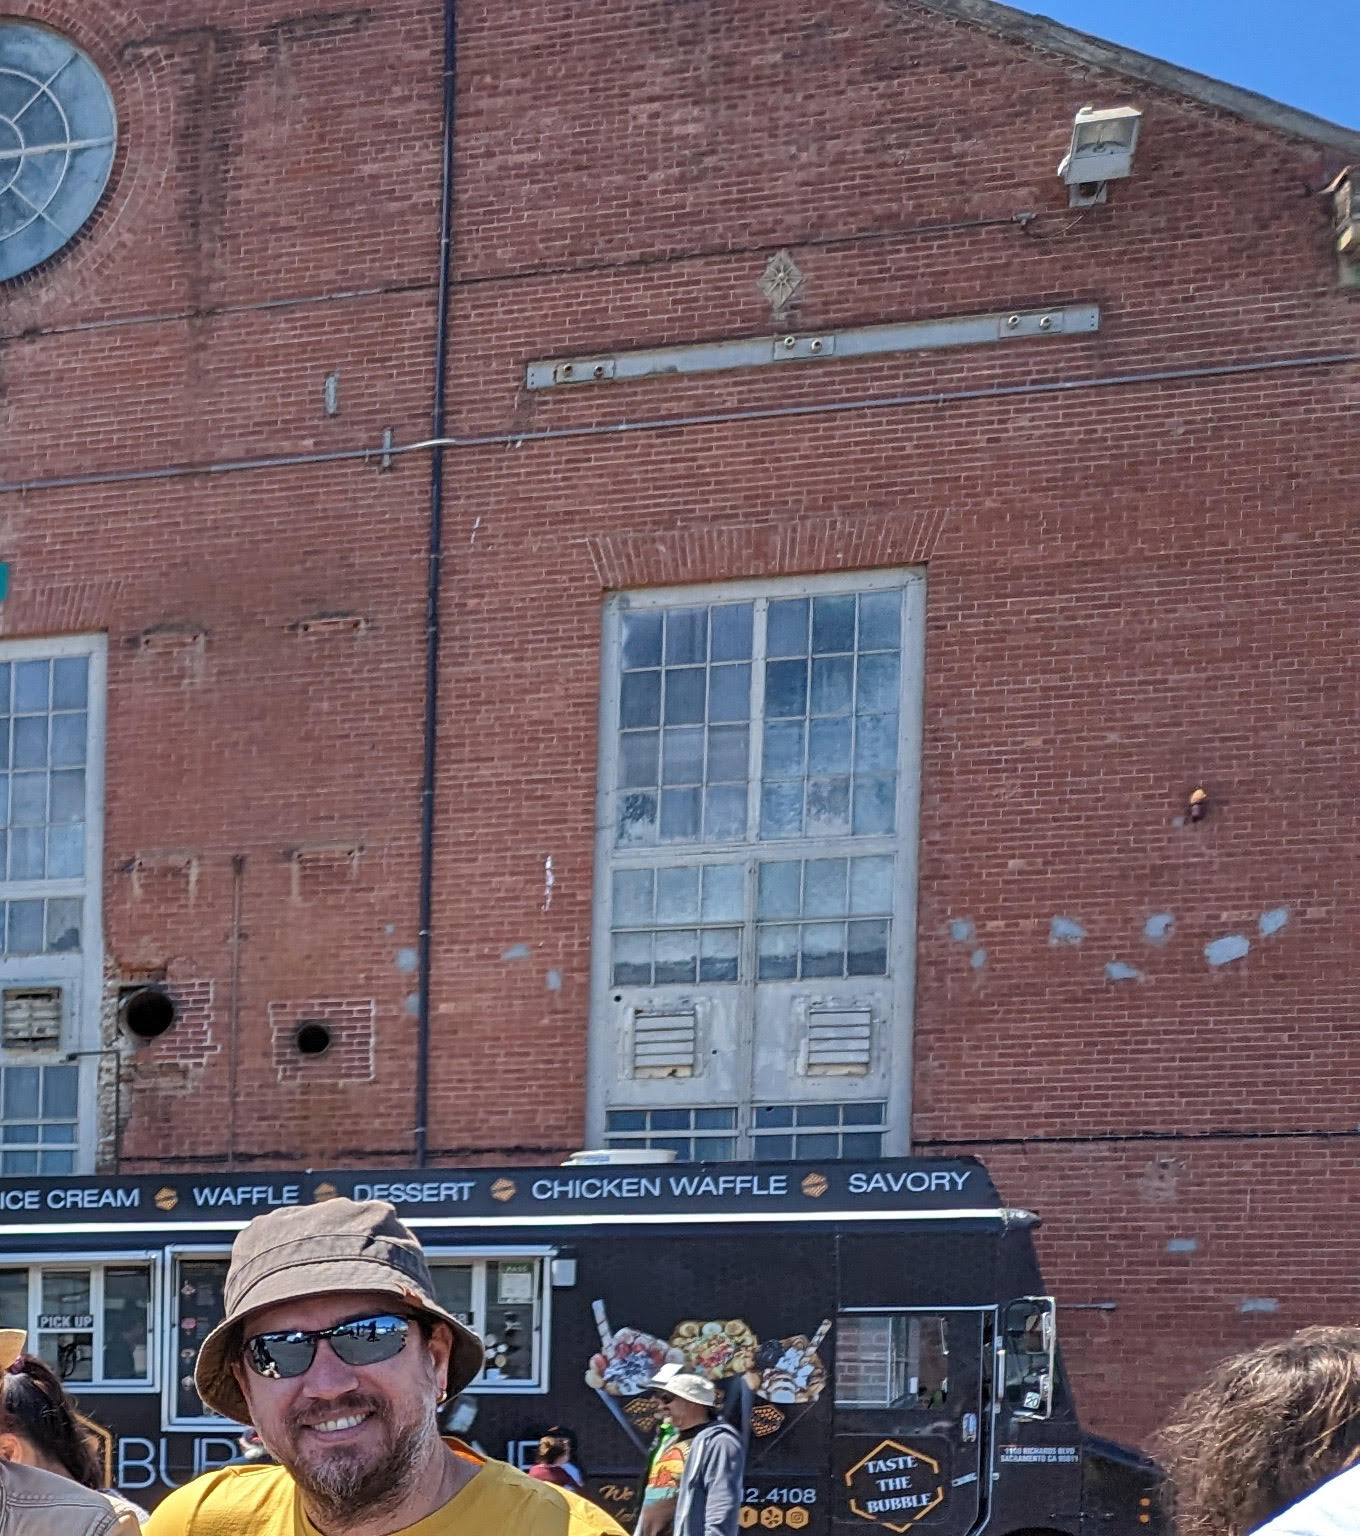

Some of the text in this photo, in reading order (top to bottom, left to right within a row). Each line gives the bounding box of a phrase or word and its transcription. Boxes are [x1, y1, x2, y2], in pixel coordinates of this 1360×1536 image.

[353, 1181, 477, 1203] DESSERT
[531, 1174, 789, 1200] CHICKEN WAFFLE
[847, 1171, 972, 1194] SAVORY
[0, 1187, 141, 1210] ICE CREAM
[192, 1184, 300, 1207] WAFFLE
[40, 1315, 92, 1329] PICK UP
[864, 1456, 918, 1474] TASTE
[875, 1476, 913, 1492] THE
[866, 1493, 934, 1513] BUBBLE
